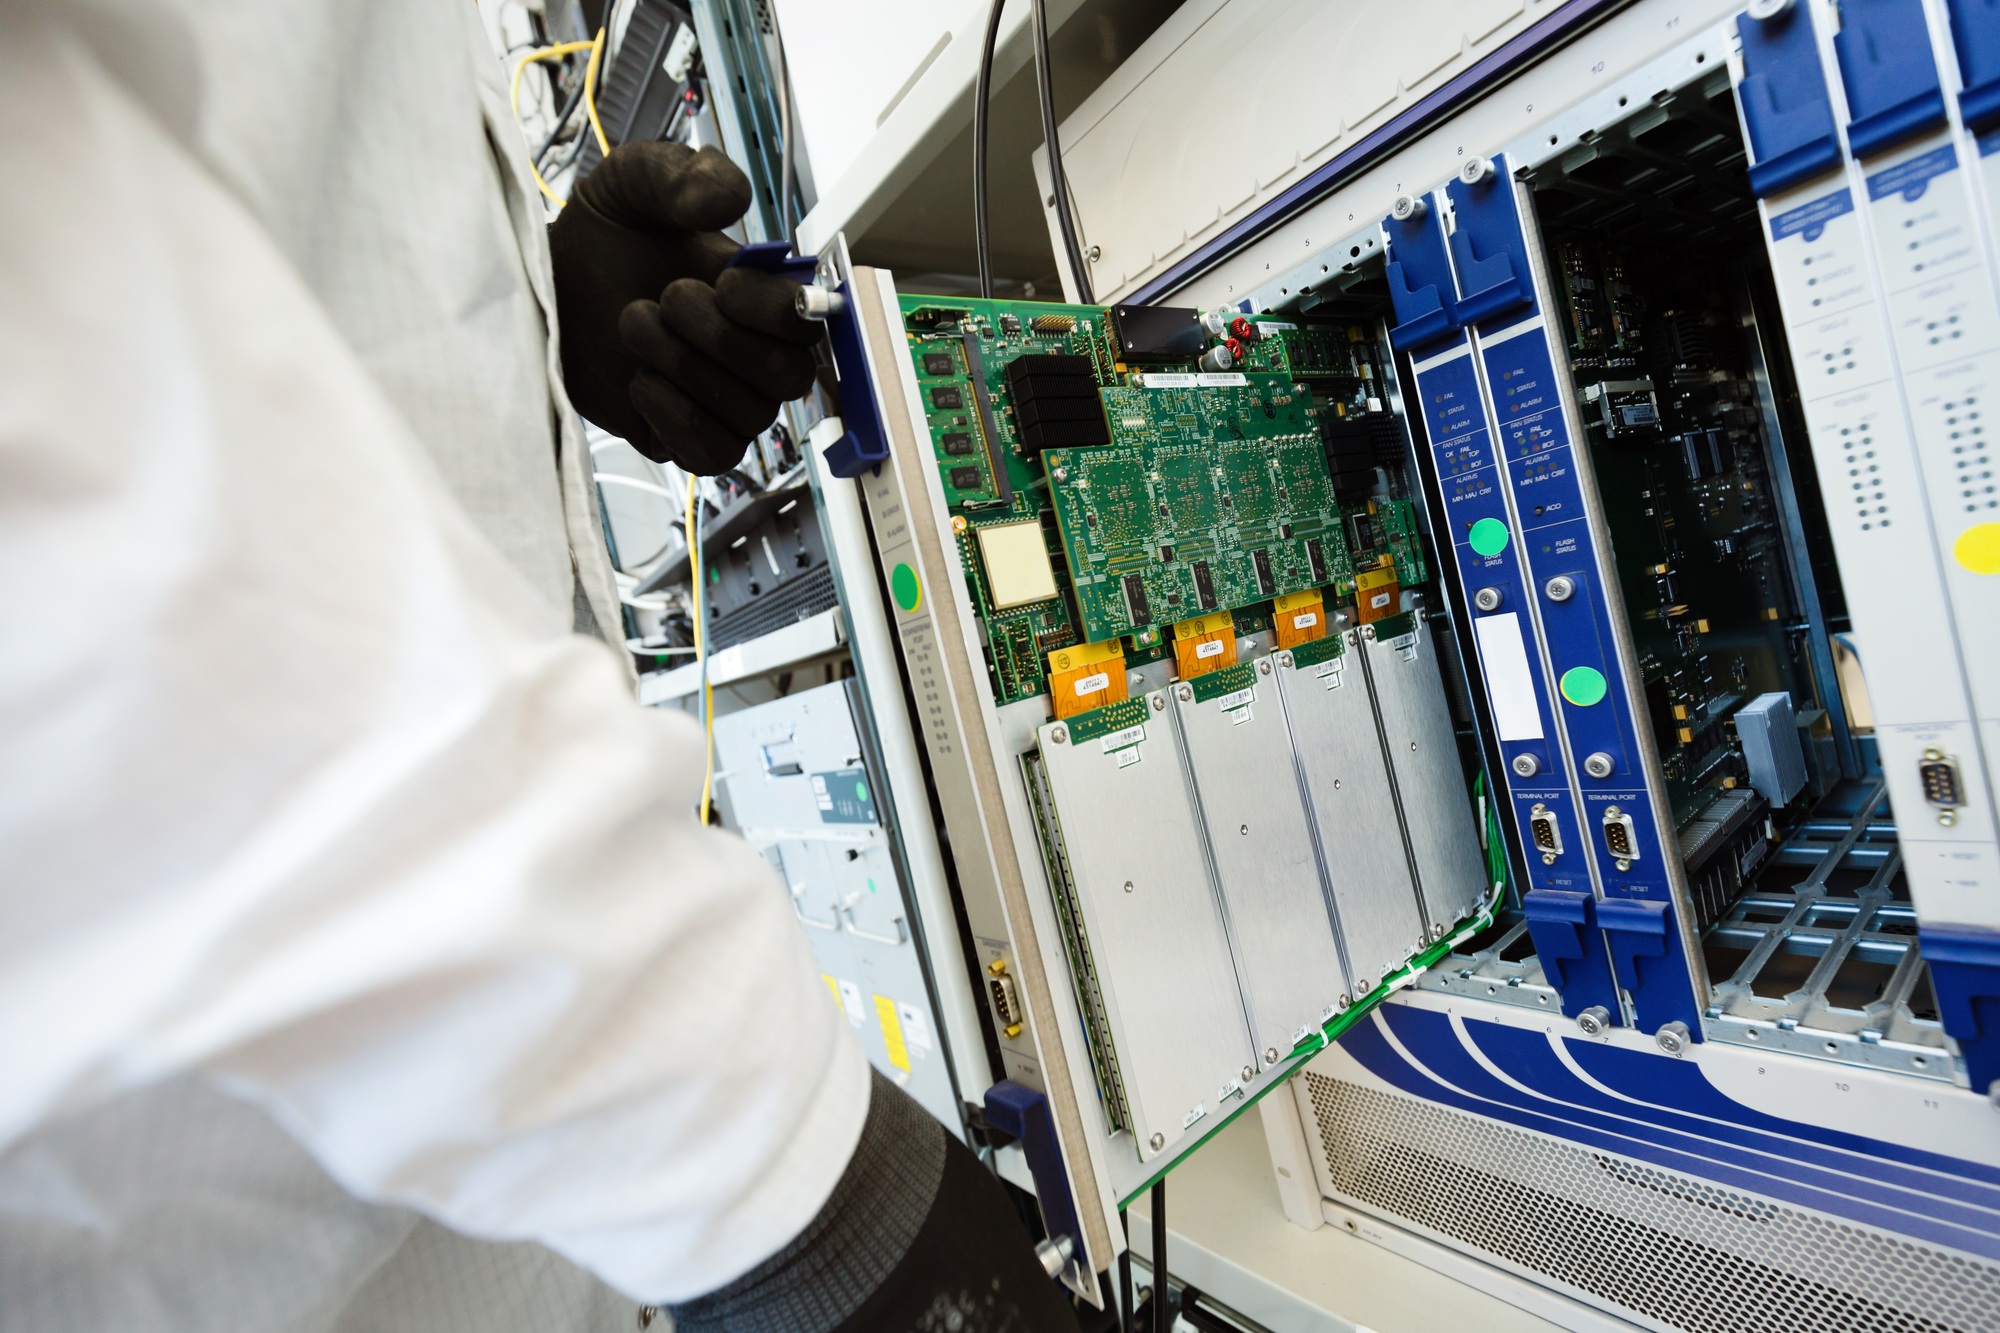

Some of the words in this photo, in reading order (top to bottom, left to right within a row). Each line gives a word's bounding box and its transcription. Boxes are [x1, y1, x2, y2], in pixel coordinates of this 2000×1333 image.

[1666, 17, 1680, 30] 11
[1590, 61, 1605, 75] 10
[1526, 104, 1534, 114] 9
[1457, 146, 1463, 156] 8
[1396, 183, 1402, 192] 7
[1348, 213, 1354, 221] 6
[1304, 239, 1310, 247] 5
[1513, 368, 1525, 376] FAIL
[1516, 381, 1537, 393] STATUS
[1443, 392, 1454, 400] FAIL
[1520, 396, 1542, 409] ALARM
[1447, 405, 1465, 415] STATUS
[1450, 419, 1470, 430] ALARM
[1510, 421, 1523, 429] FAN
[1523, 414, 1543, 425] STATUS
[1513, 430, 1523, 438] OK
[1530, 424, 1542, 433] FAIL
[1540, 428, 1553, 438] TOP
[1442, 441, 1453, 449] FAN
[1454, 435, 1471, 446] STATUS
[1542, 440, 1555, 449] BOT
[1468, 450, 1480, 458] TOP
[1470, 460, 1482, 469] BOT
[1525, 454, 1550, 466] ALARMS
[1456, 473, 1478, 484] ALARMS
[1520, 478, 1533, 486] MIN
[1534, 474, 1549, 482] MAJ
[1550, 468, 1566, 477] CRIT
[1452, 495, 1464, 503] MIN
[1465, 491, 1478, 499] MAJ
[1479, 487, 1492, 495] CRIT
[1545, 502, 1562, 512] ACO
[1555, 538, 1575, 547] FLASH
[1556, 544, 1577, 554] STATUS
[1485, 558, 1503, 567] STATUS
[1546, 1026, 1552, 1034] 6
[1758, 1066, 1766, 1075] 9
[1834, 1082, 1850, 1092] 10
[1923, 1099, 1939, 1109] 11
